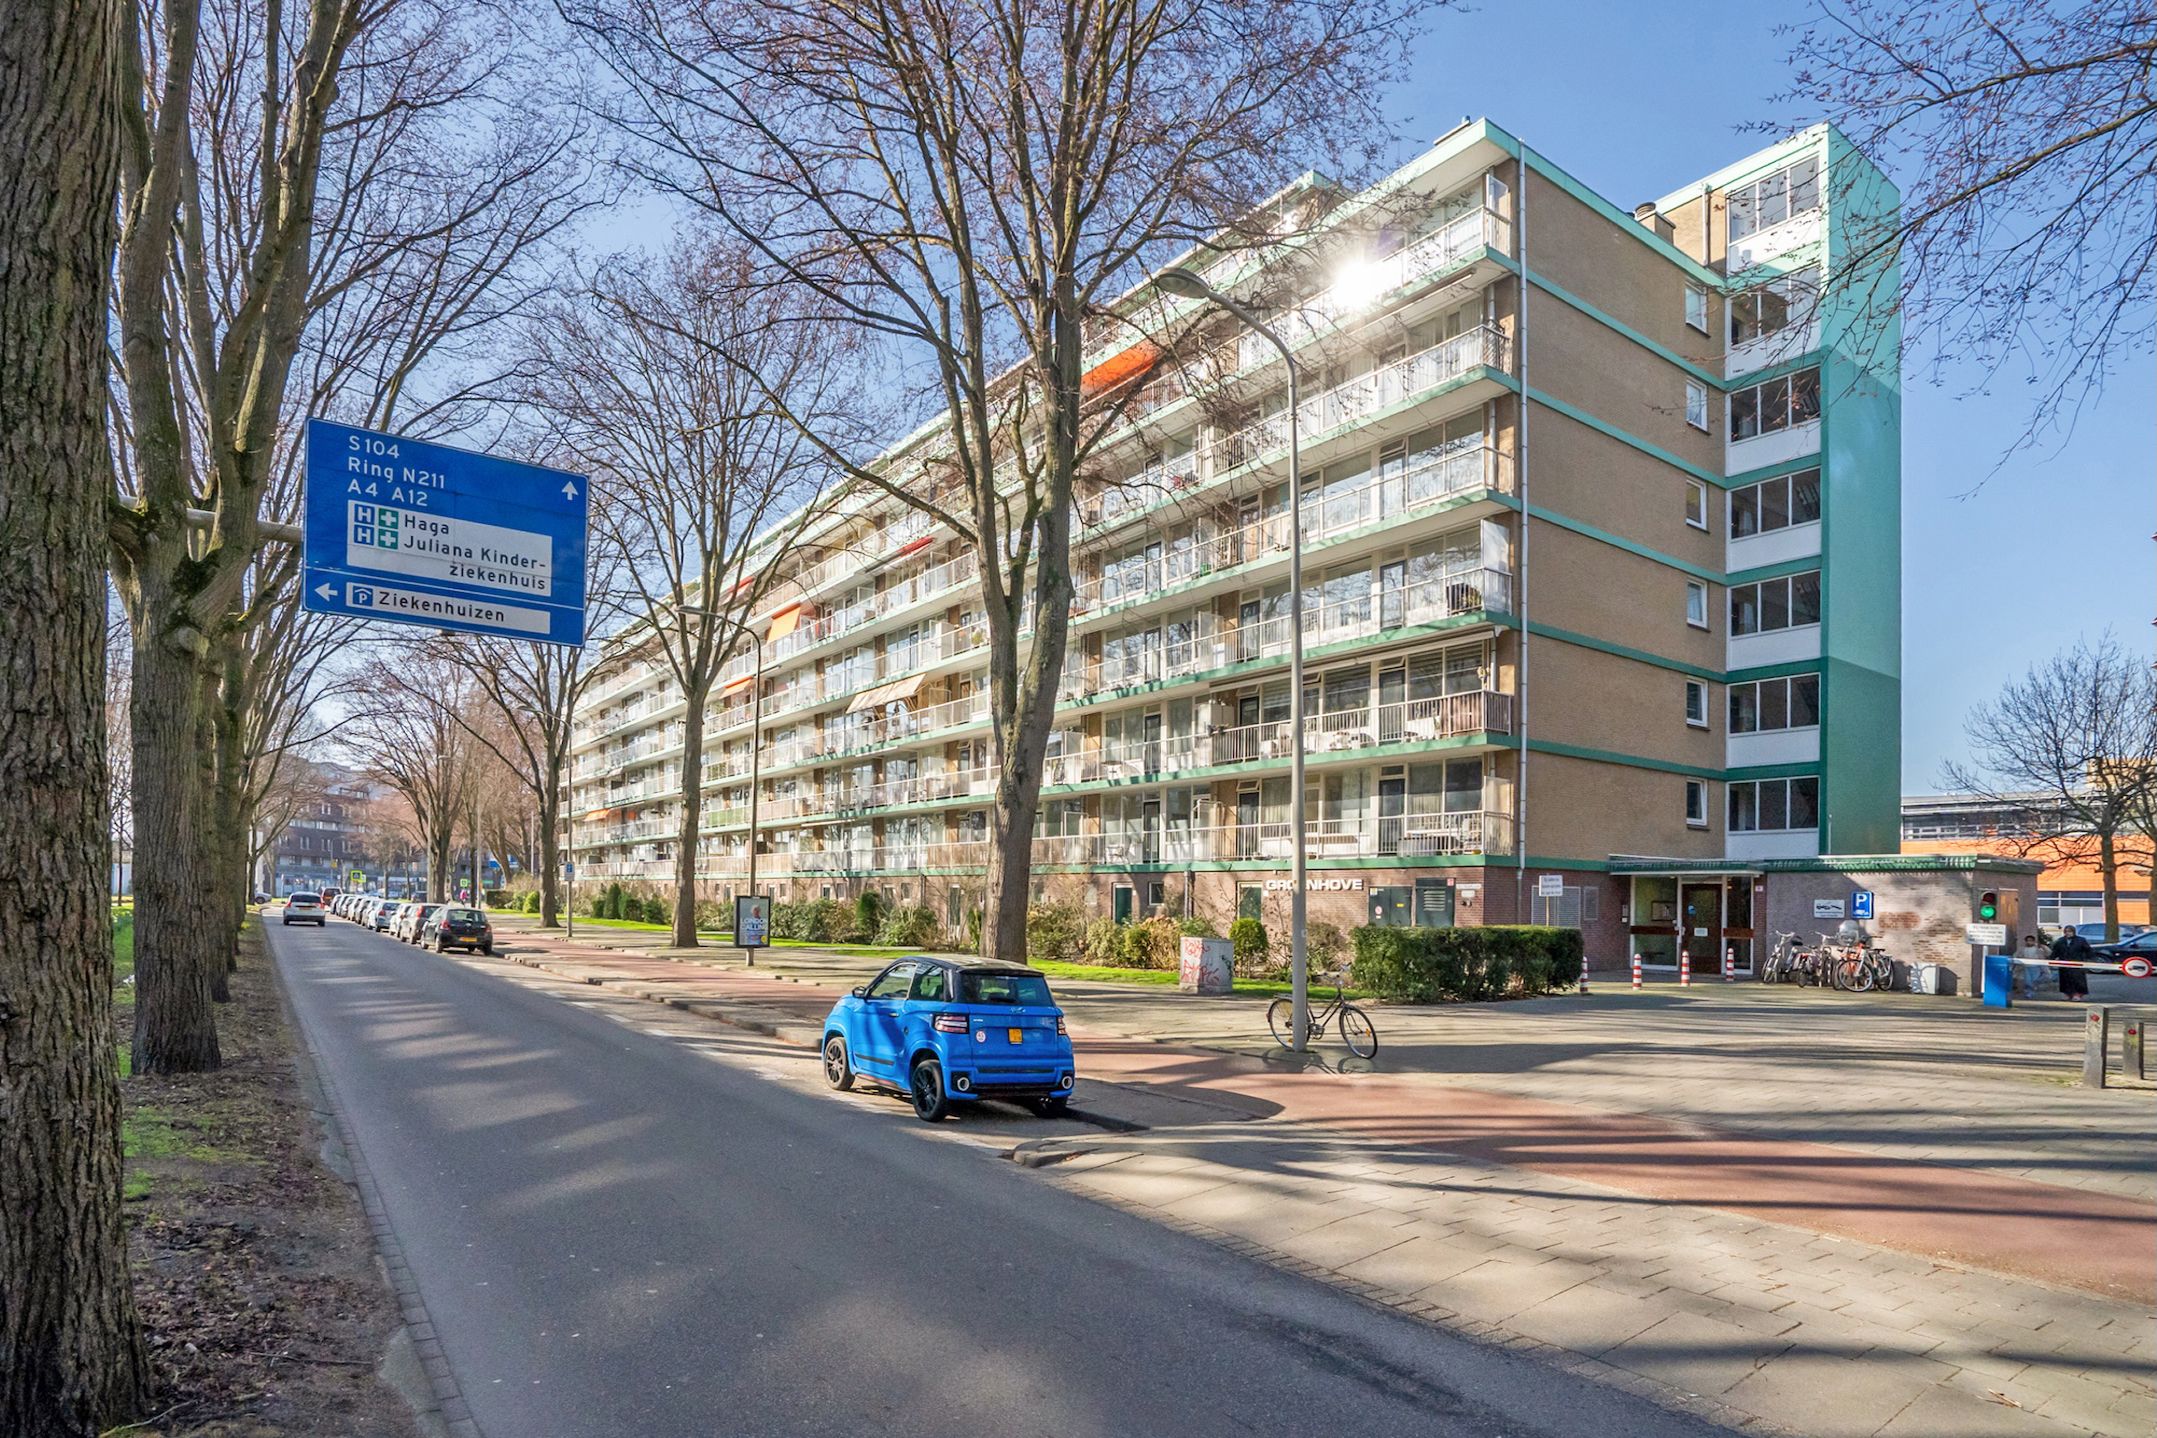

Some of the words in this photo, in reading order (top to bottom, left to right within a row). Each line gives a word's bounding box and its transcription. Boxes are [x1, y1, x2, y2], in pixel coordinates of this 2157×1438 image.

[348, 456, 394, 484] Ring
[403, 467, 445, 489] N211
[391, 486, 428, 507] A12
[404, 514, 450, 537] Haga
[404, 535, 473, 559] Juliana
[481, 548, 546, 569] Kinder-
[450, 563, 546, 590] ziekenhuis
[379, 591, 505, 622] Ziekenhuizen
[1856, 893, 1868, 907] P
